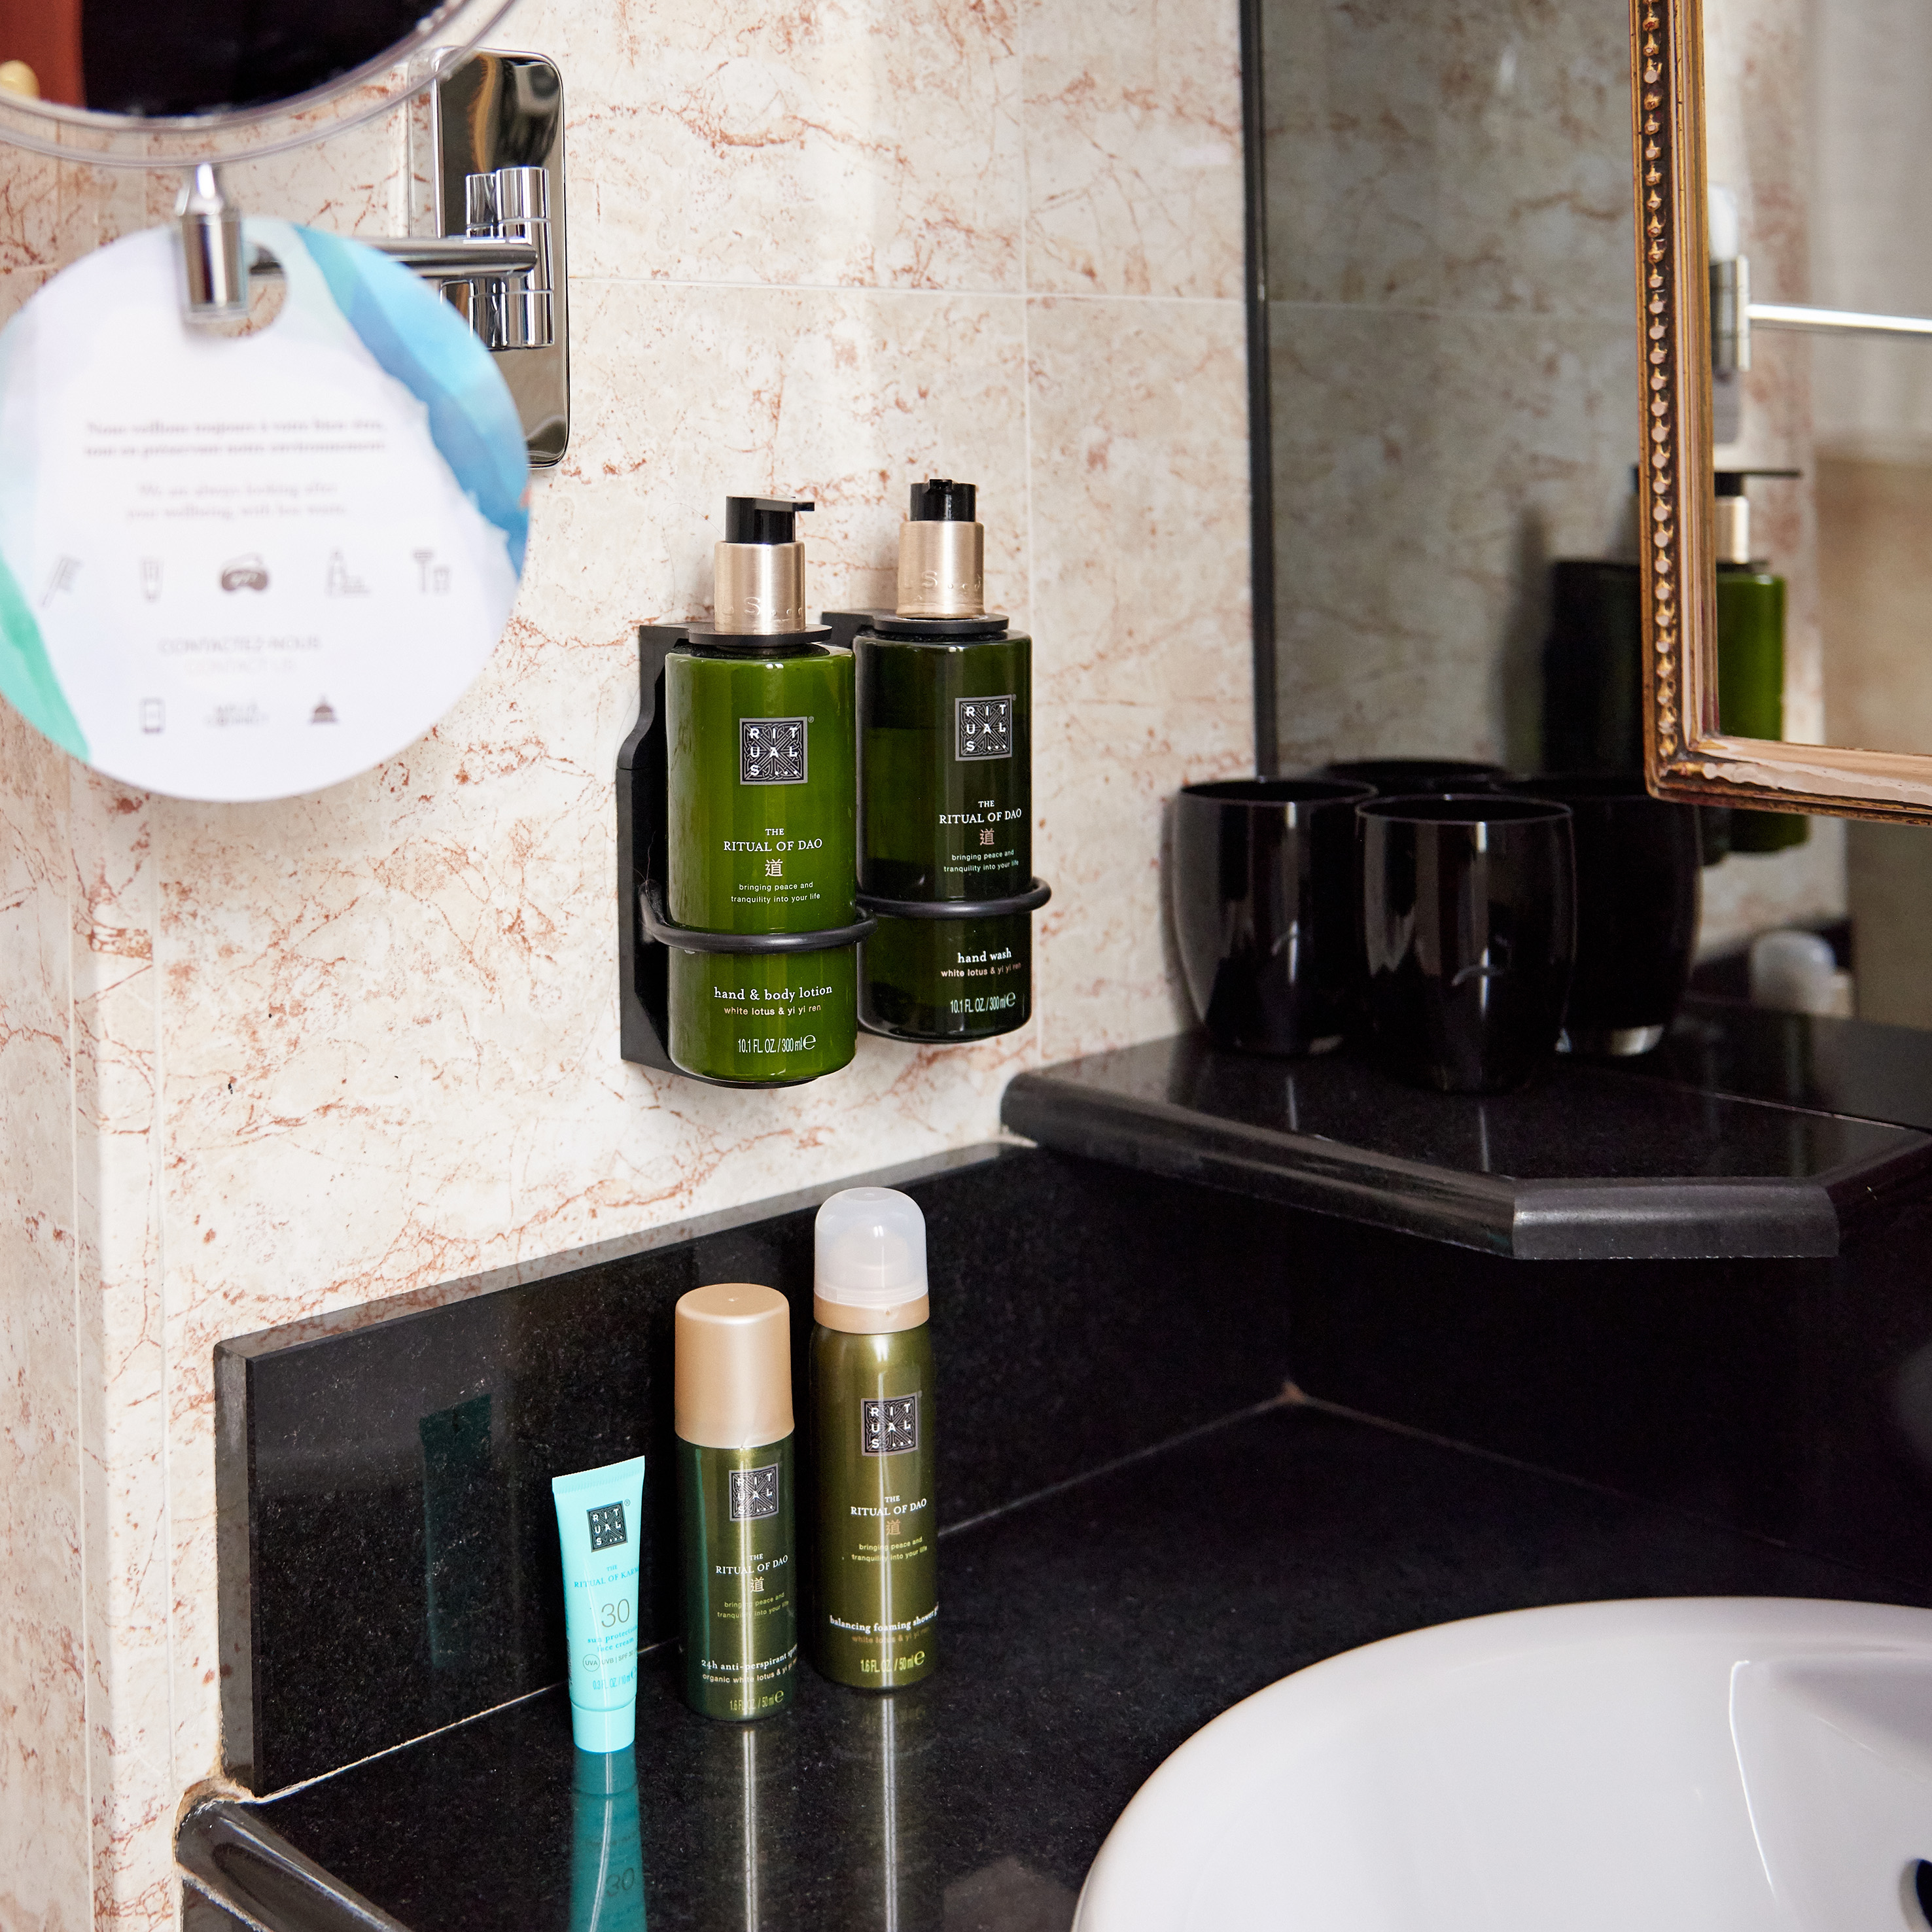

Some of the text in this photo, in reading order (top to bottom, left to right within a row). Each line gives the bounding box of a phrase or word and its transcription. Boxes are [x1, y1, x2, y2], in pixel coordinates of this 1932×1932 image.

[940, 809, 1021, 824] RITUAL OF DAO
[980, 828, 994, 845] 道
[724, 838, 822, 851] RITUAL OF DAO
[952, 853, 981, 862] bringing
[984, 852, 1002, 860] peace
[765, 859, 783, 877] 道
[791, 895, 808, 904] your
[958, 947, 1011, 963] hand wash
[998, 966, 1004, 975] yi
[1006, 964, 1011, 974] yi
[714, 986, 832, 1002] hand & body lotion
[788, 1007, 795, 1015] yi
[799, 1006, 805, 1015] yi
[950, 1000, 963, 1013] 10.1
[738, 1038, 751, 1053] 10.1
[851, 1498, 926, 1516] RITUAL OF DAO
[886, 1519, 900, 1536] 道
[891, 1541, 911, 1551] peace
[913, 1536, 922, 1545] and
[905, 1550, 918, 1558] your
[716, 1555, 788, 1574] RITUAL OF DAO
[574, 1577, 606, 1588] RITUAL
[608, 1573, 618, 1582] OF
[750, 1577, 764, 1592] 道
[756, 1597, 773, 1607] peace
[775, 1592, 784, 1600] and
[601, 1599, 629, 1627] 30
[769, 1606, 781, 1614] your
[830, 1615, 871, 1634] balancing
[873, 1621, 911, 1632] foaming
[913, 1610, 934, 1626] shower
[616, 1637, 634, 1648] cream
[701, 1660, 718, 1669] 24h
[721, 1653, 787, 1672] anti-perspirant
[703, 1674, 730, 1683] organic
[757, 1672, 775, 1681] lotus
